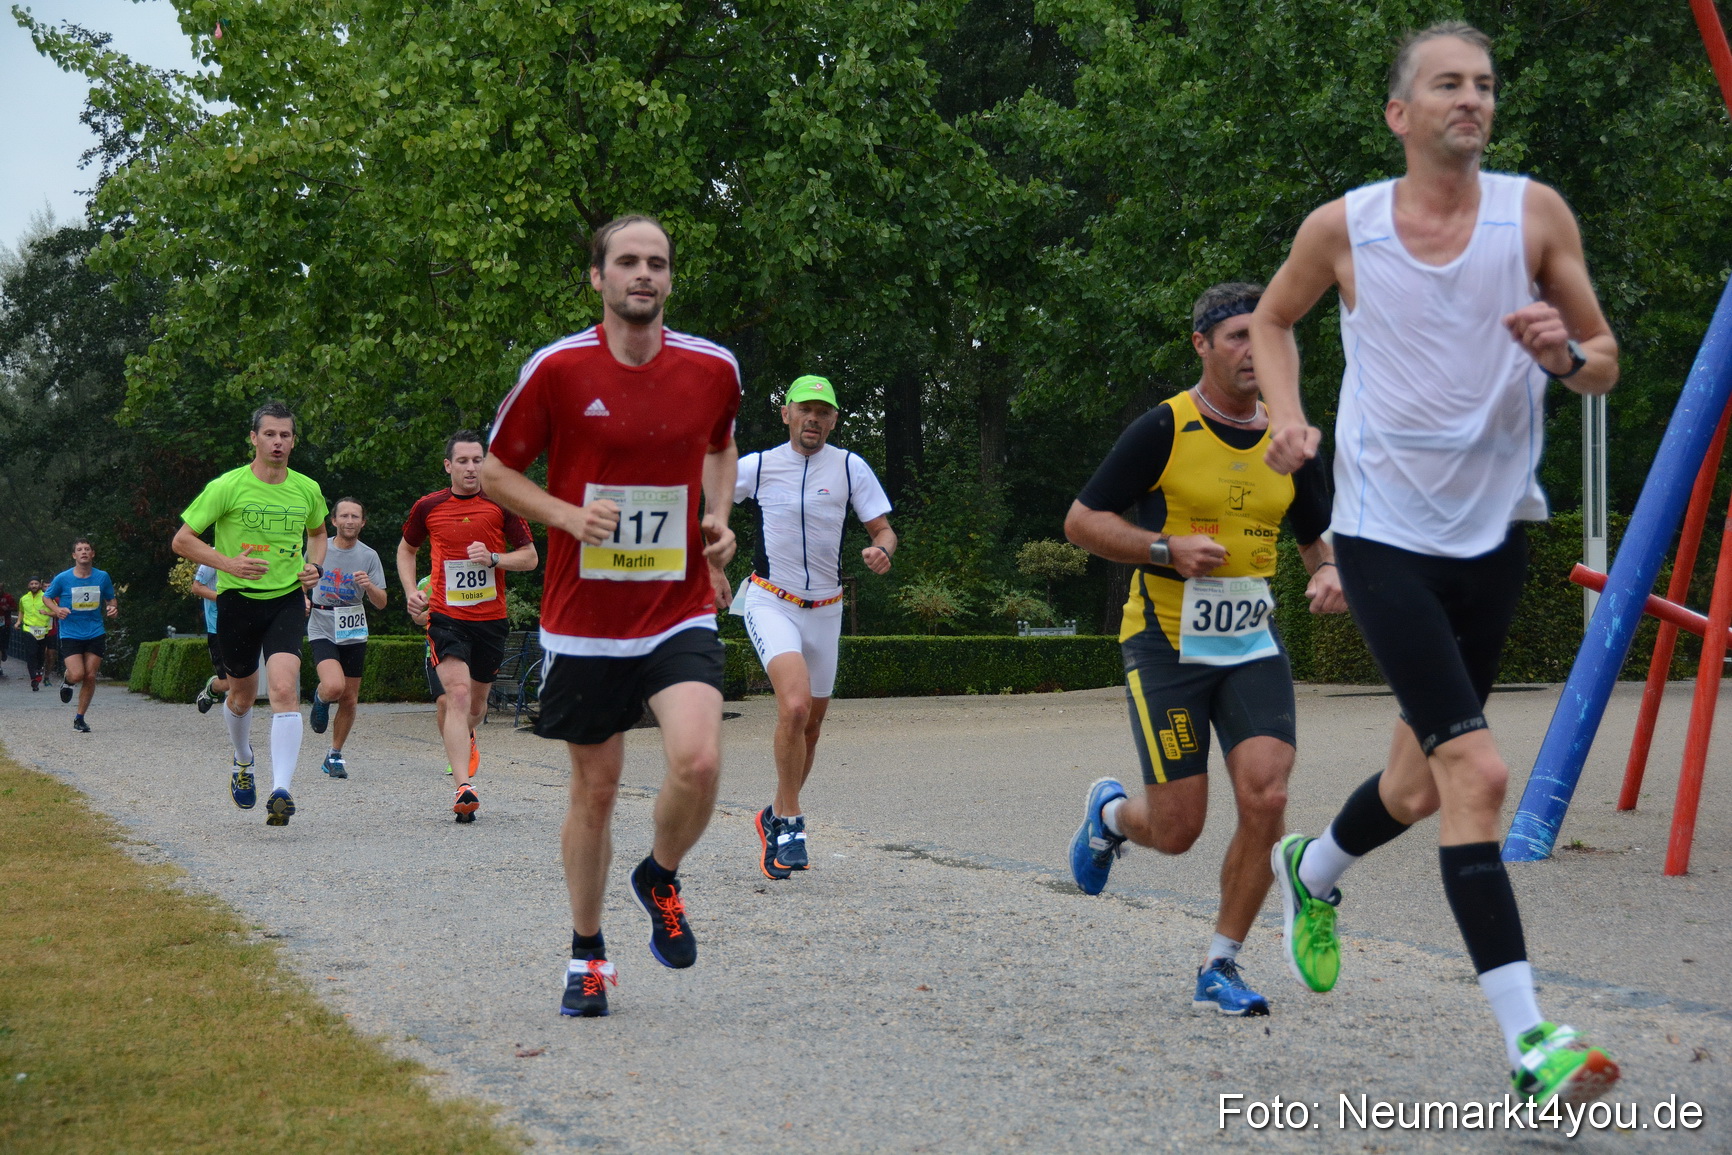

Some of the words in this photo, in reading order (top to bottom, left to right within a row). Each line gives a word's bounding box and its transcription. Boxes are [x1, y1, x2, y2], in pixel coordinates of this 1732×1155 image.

[632, 490, 679, 501] BOCK
[1190, 523, 1219, 535] Seidl
[613, 553, 655, 568] Martin
[456, 570, 487, 588] 289
[755, 578, 778, 593] LEKI
[84, 592, 90, 602] 3
[339, 613, 365, 629] 3026
[1193, 599, 1268, 632] 3029
[1173, 714, 1195, 748] Run!
[1165, 731, 1178, 757] Team
